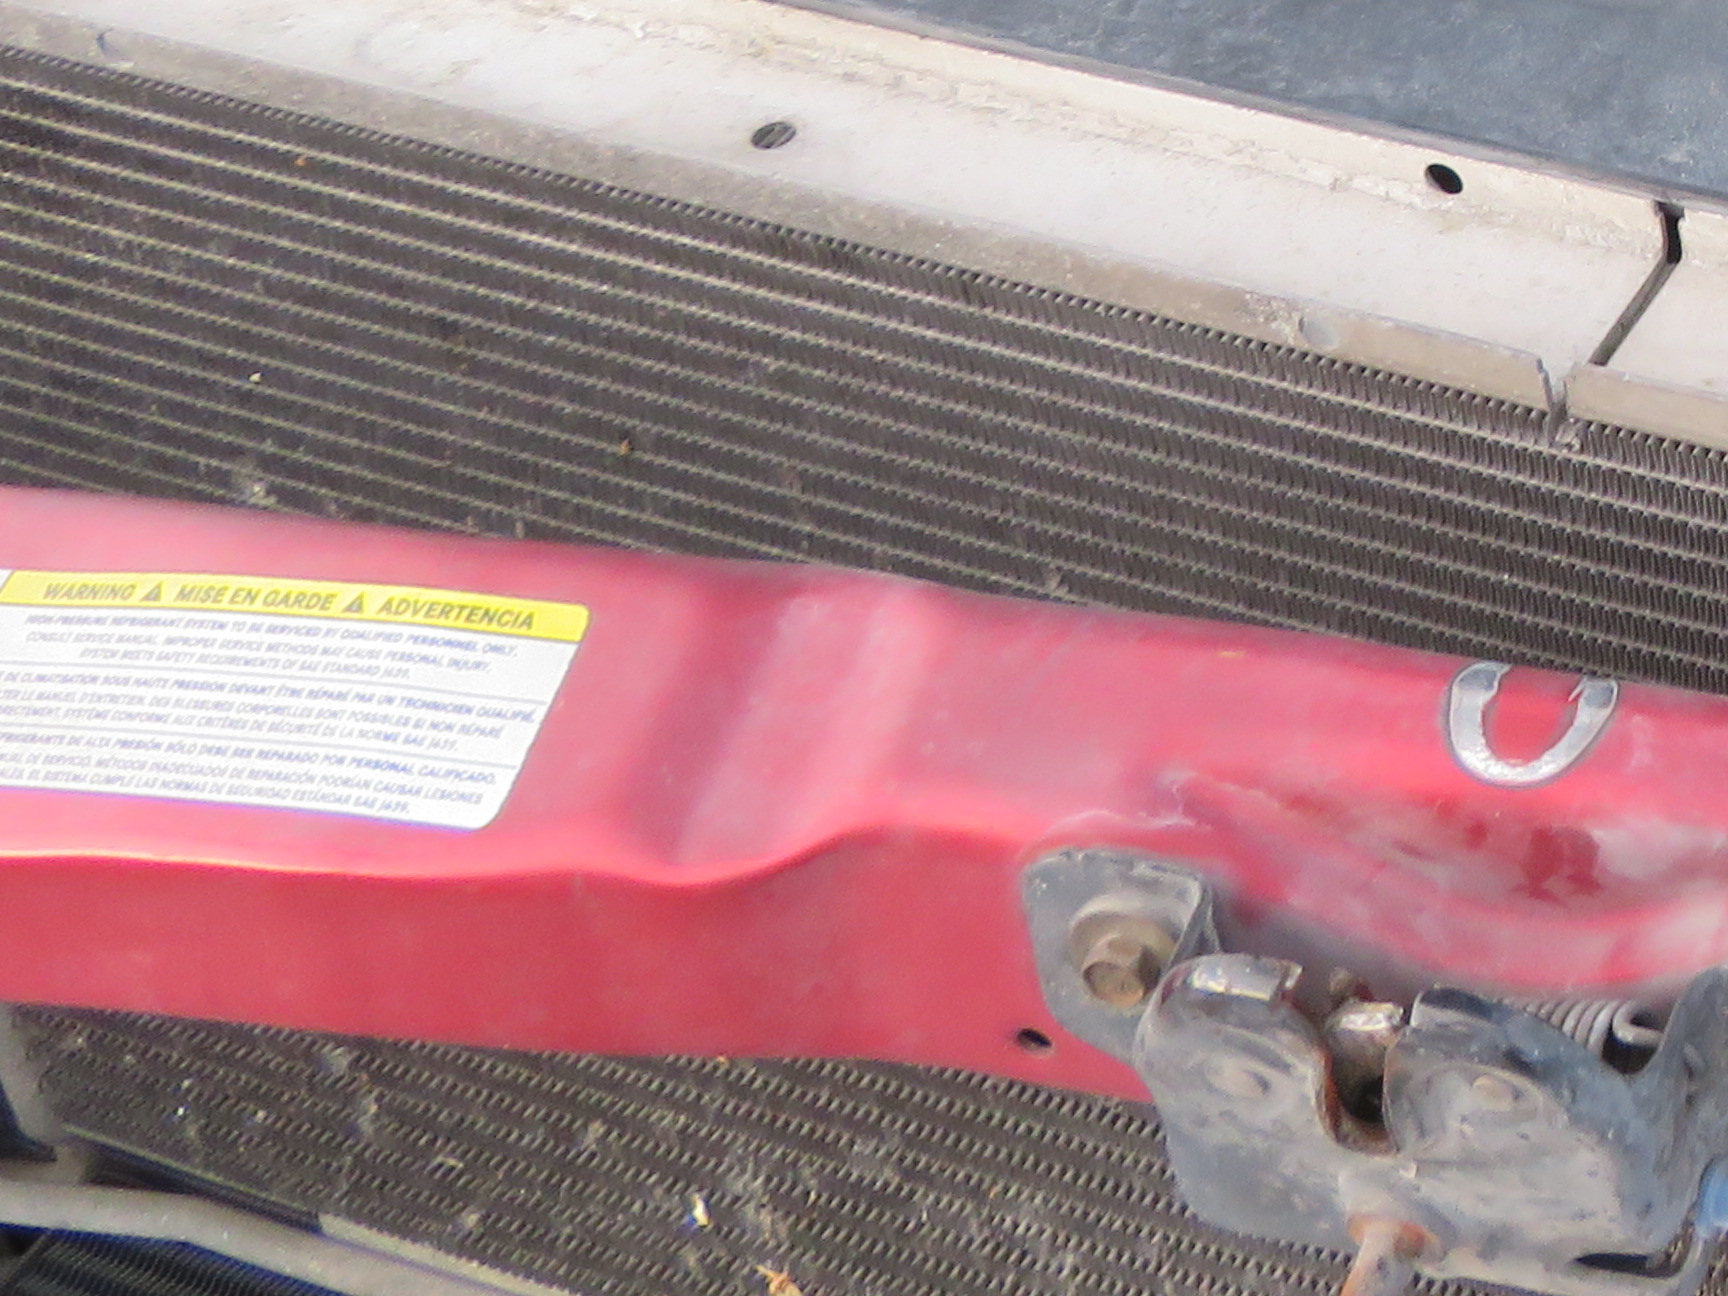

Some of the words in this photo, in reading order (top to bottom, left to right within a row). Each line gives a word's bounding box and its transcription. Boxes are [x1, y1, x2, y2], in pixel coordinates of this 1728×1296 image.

[43, 582, 137, 600] WARNING
[173, 583, 229, 603] MISE
[228, 587, 261, 606] EN
[262, 589, 338, 611] GARDE
[376, 596, 537, 631] ADVERTENCIA
[231, 621, 246, 632] TO
